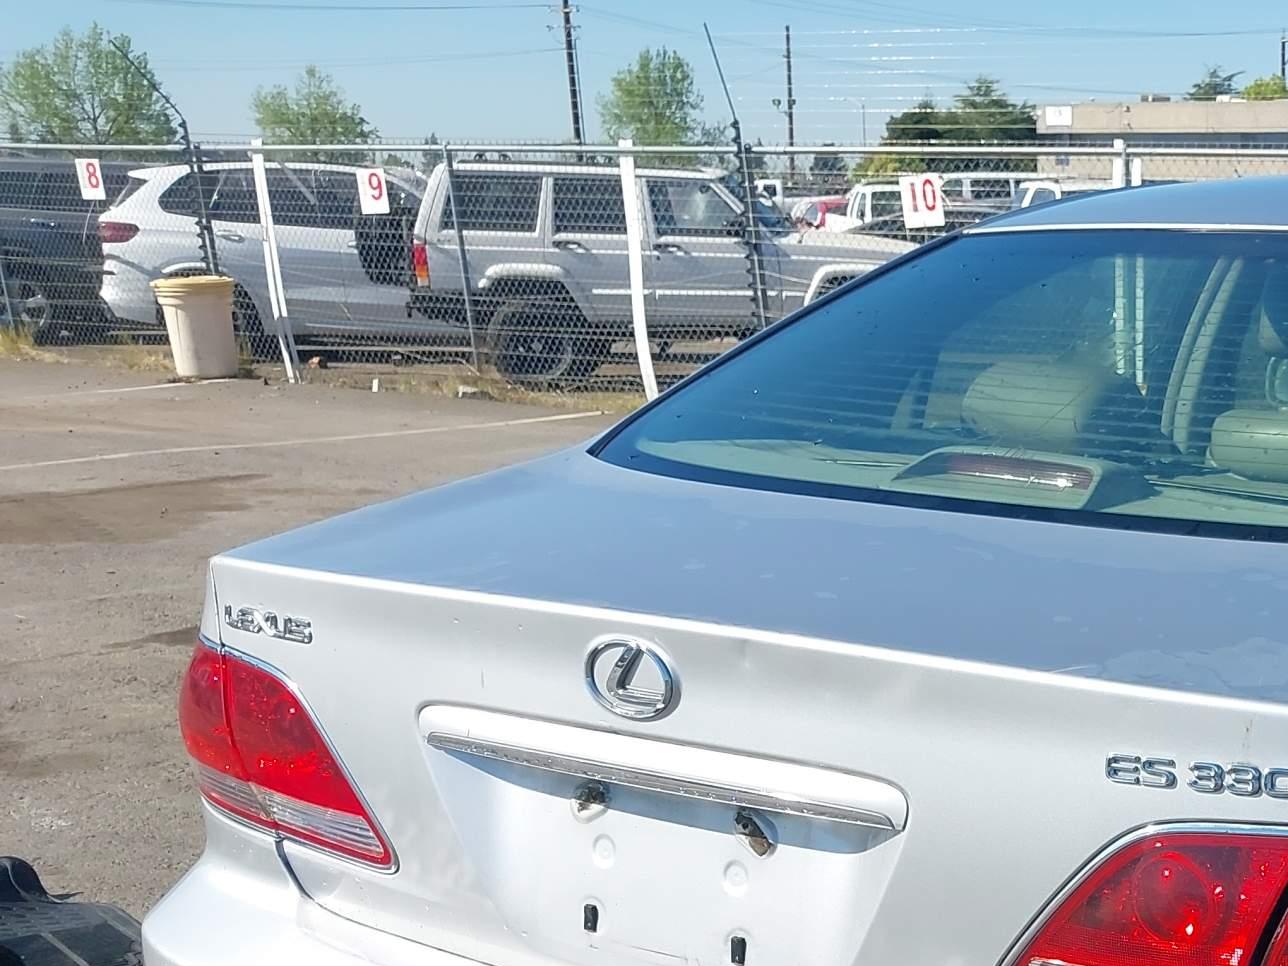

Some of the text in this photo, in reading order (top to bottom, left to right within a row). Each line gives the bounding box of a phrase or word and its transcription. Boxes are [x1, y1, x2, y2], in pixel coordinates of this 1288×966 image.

[86, 162, 100, 189] 8
[368, 172, 383, 201] 9
[910, 178, 936, 213] 10
[224, 604, 313, 645] LEXUS
[1104, 752, 1179, 790] ES
